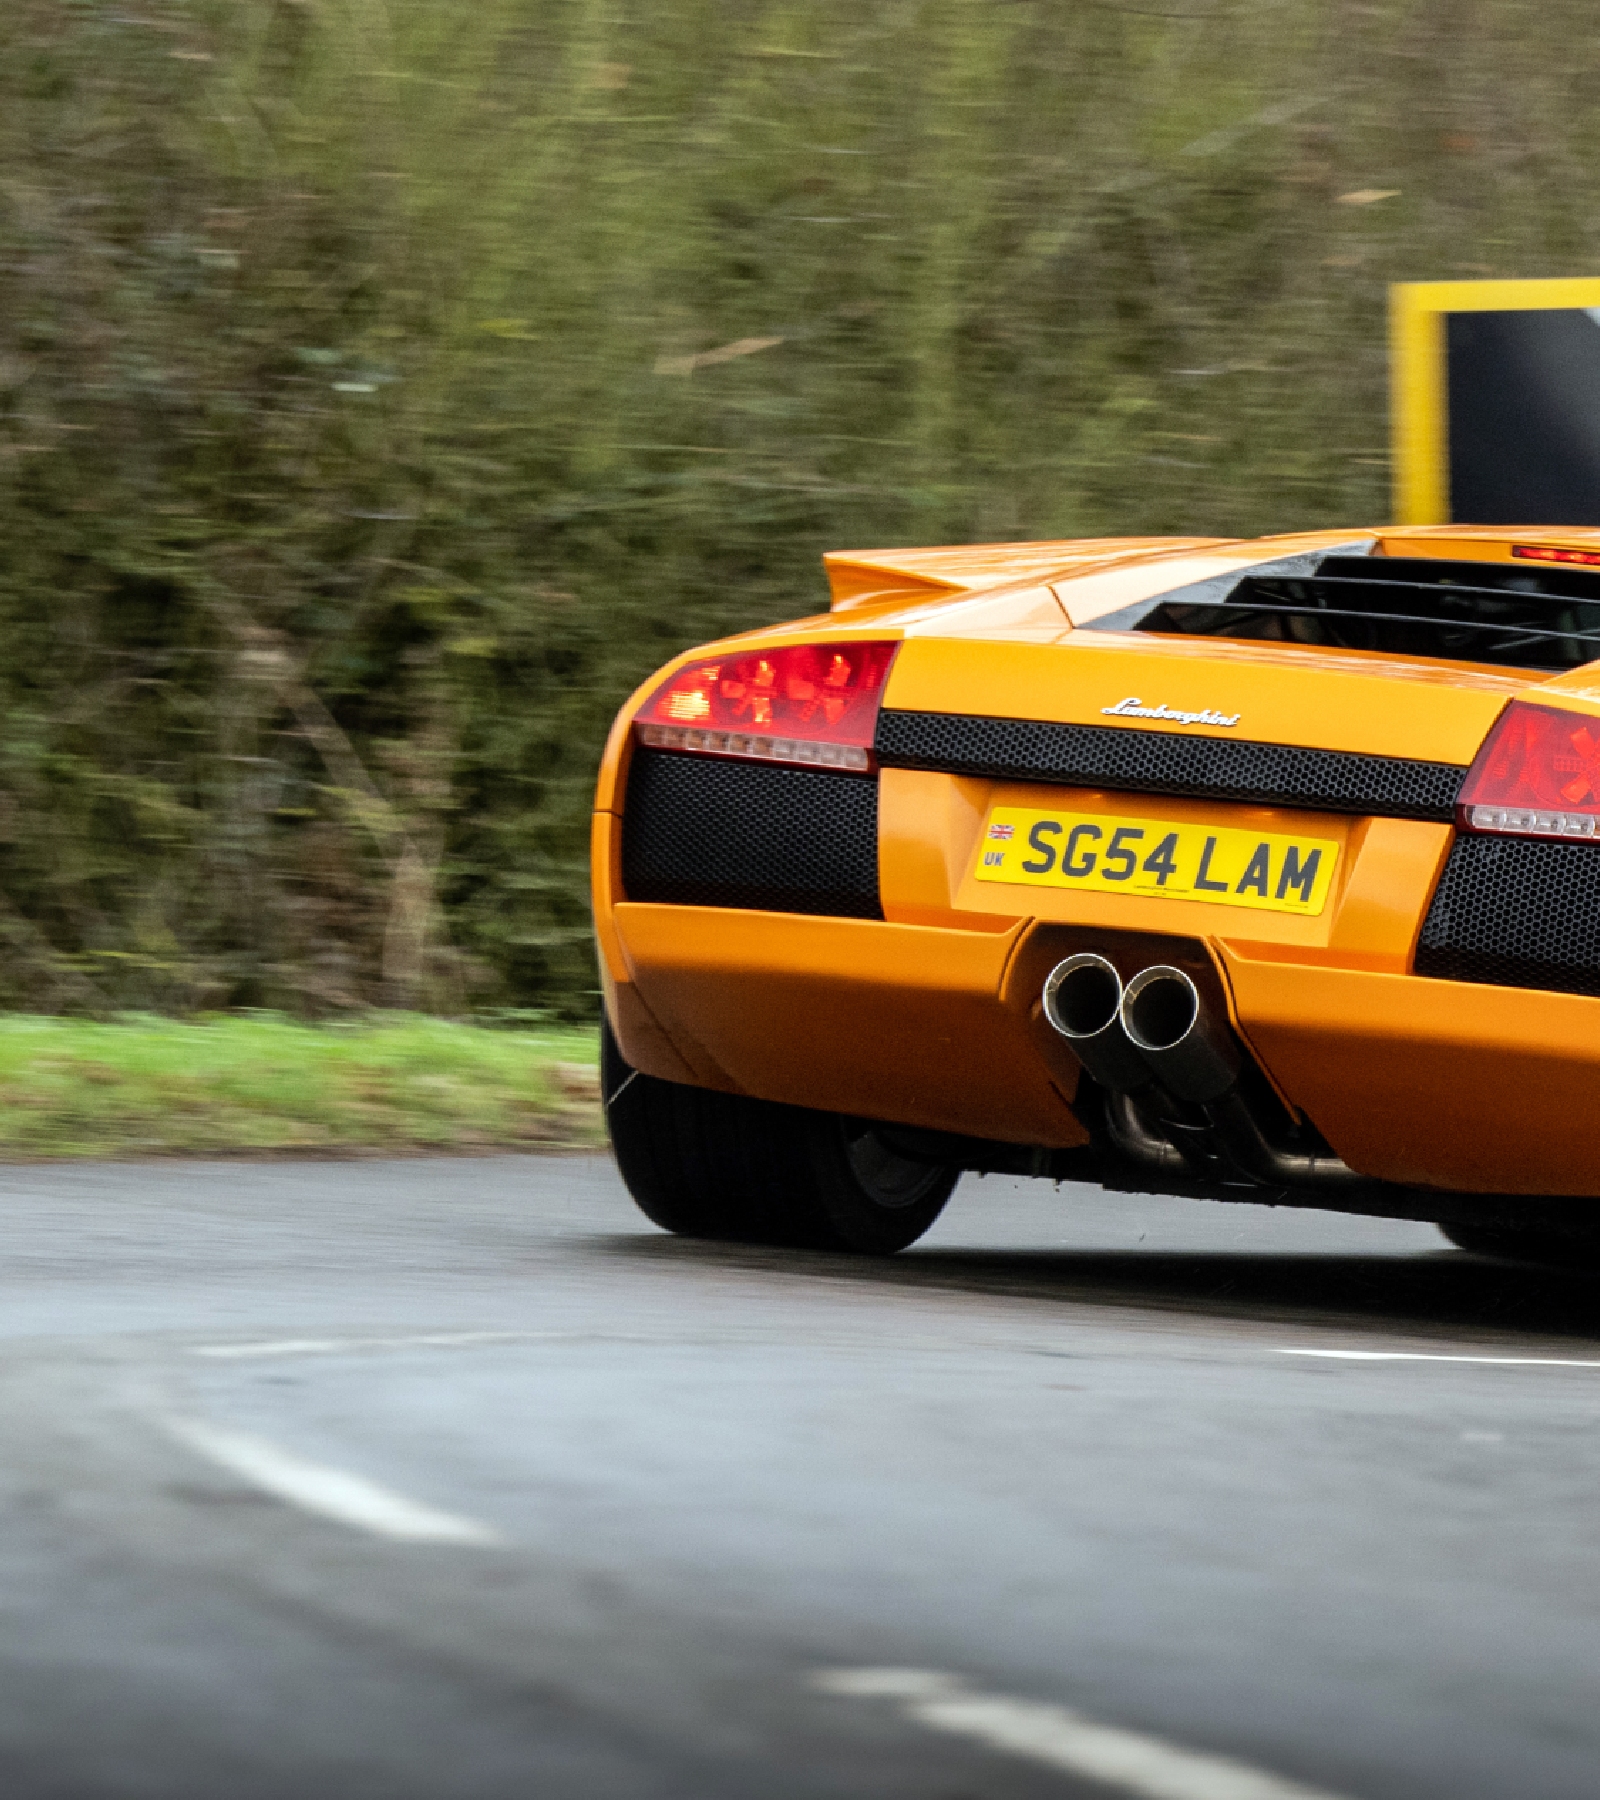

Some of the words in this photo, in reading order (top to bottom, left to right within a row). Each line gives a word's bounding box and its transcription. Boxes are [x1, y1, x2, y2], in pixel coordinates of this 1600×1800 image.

[1100, 697, 1241, 727] Lamborghini
[984, 852, 1005, 866] UK
[1021, 820, 1180, 886] SG54
[1193, 835, 1323, 903] LAM
